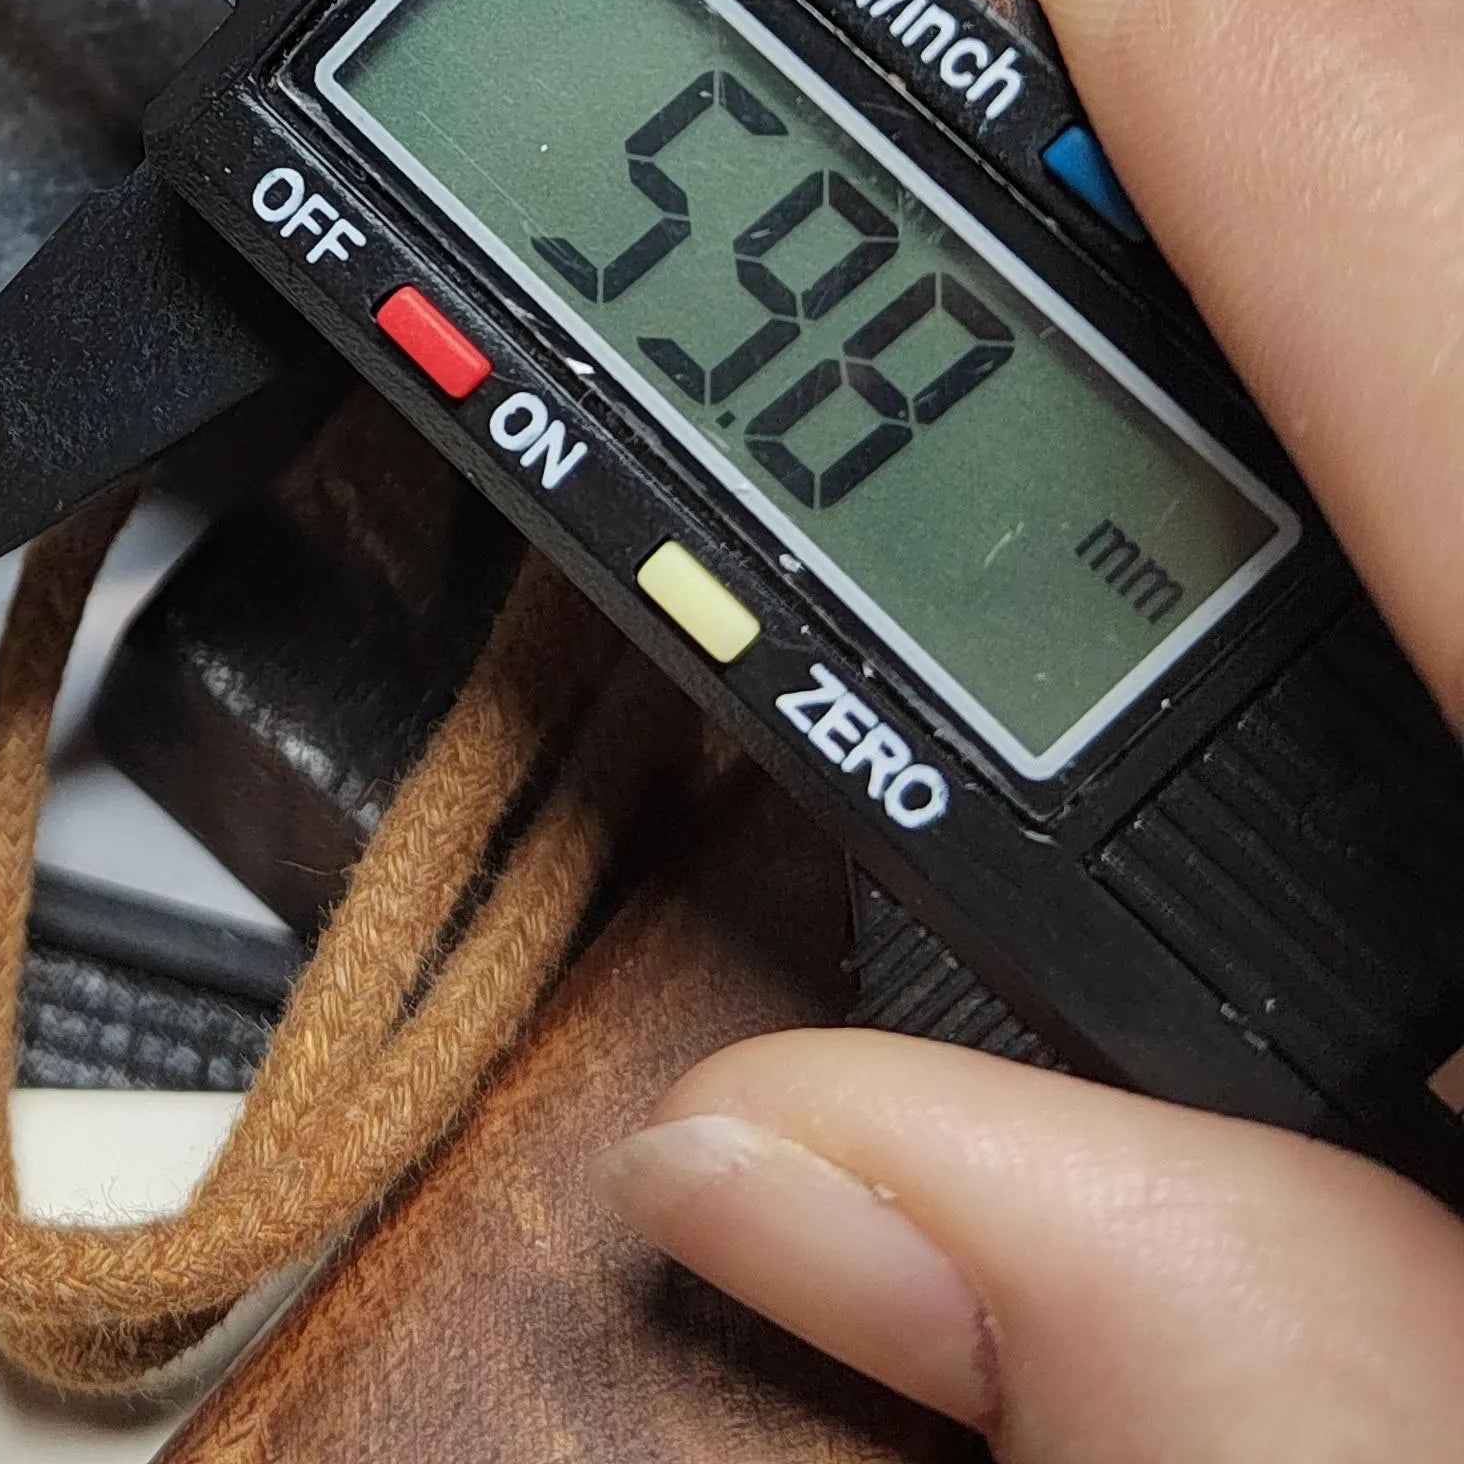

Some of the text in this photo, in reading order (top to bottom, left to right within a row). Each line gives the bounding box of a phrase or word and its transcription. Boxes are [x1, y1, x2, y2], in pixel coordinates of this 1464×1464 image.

[252, 166, 367, 266] OFF
[531, 68, 1184, 625] 59.8 mm
[488, 389, 588, 490] ON
[775, 662, 950, 828] ZERO
